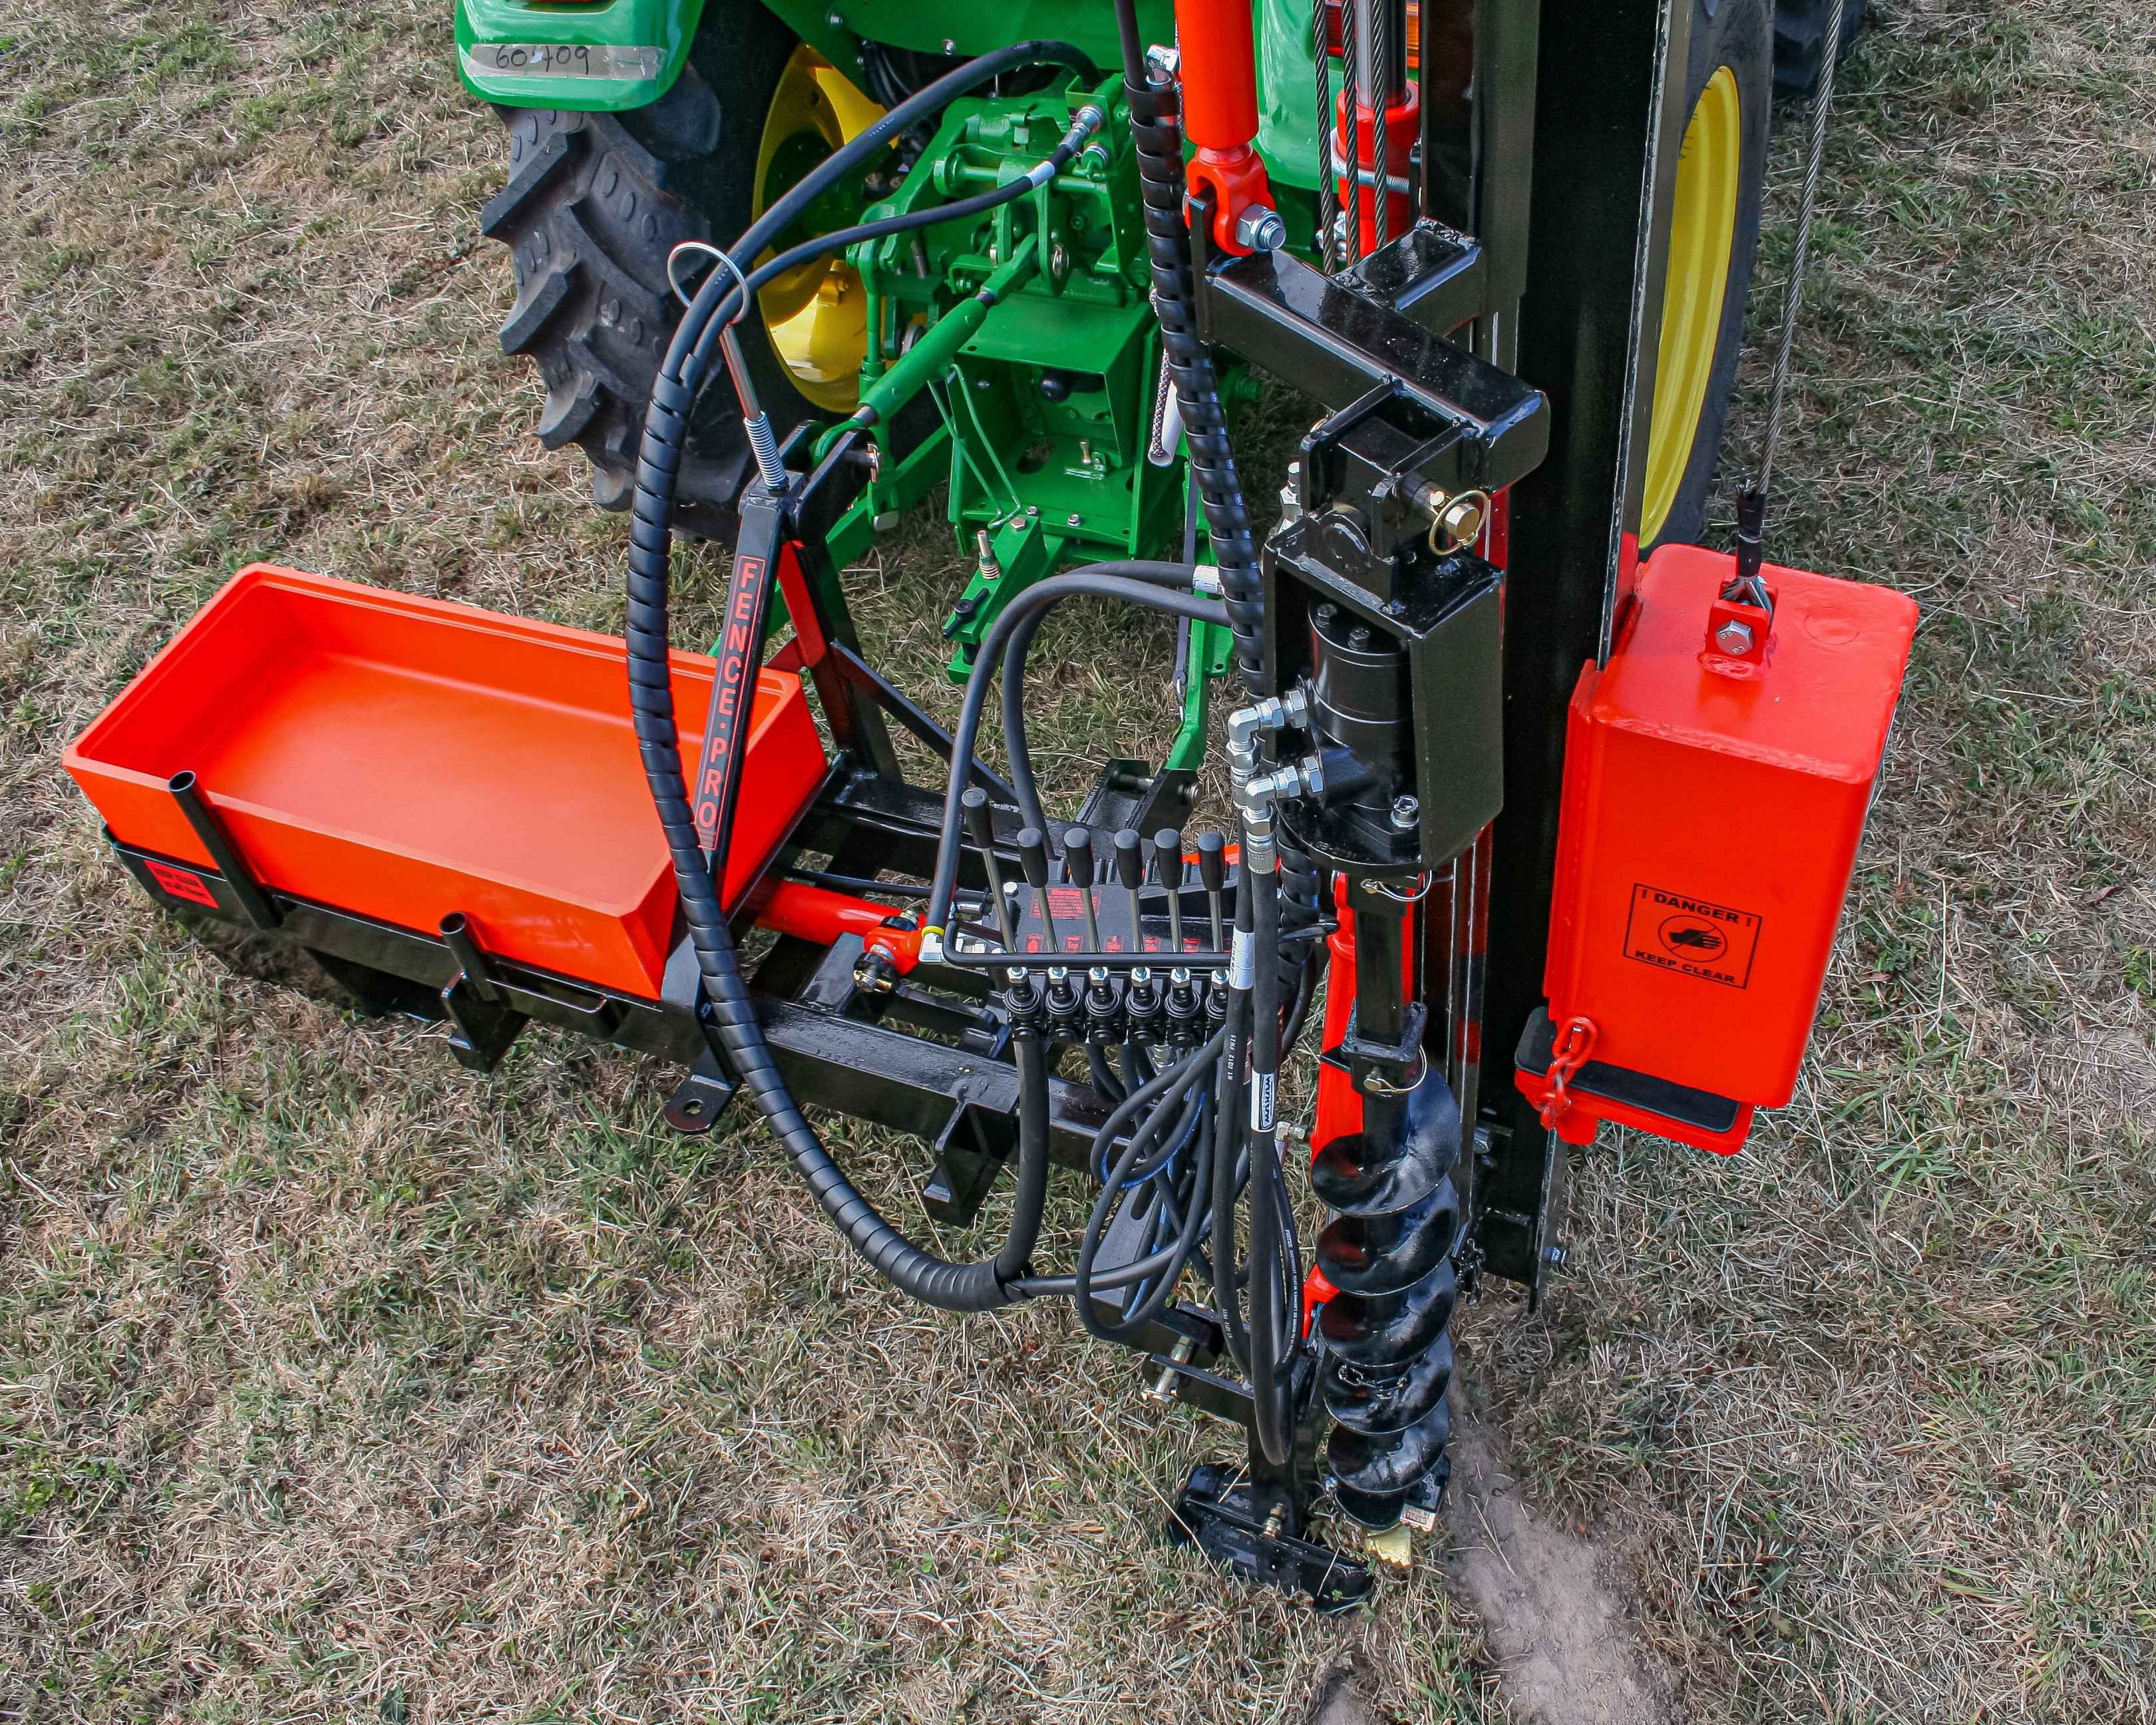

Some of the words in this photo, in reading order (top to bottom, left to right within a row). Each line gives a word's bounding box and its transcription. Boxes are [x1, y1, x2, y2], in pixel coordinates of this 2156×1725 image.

[1654, 892, 1739, 924] DANGER
[1635, 950, 1677, 967] KEEP
[1682, 963, 1735, 984] CLEAR
